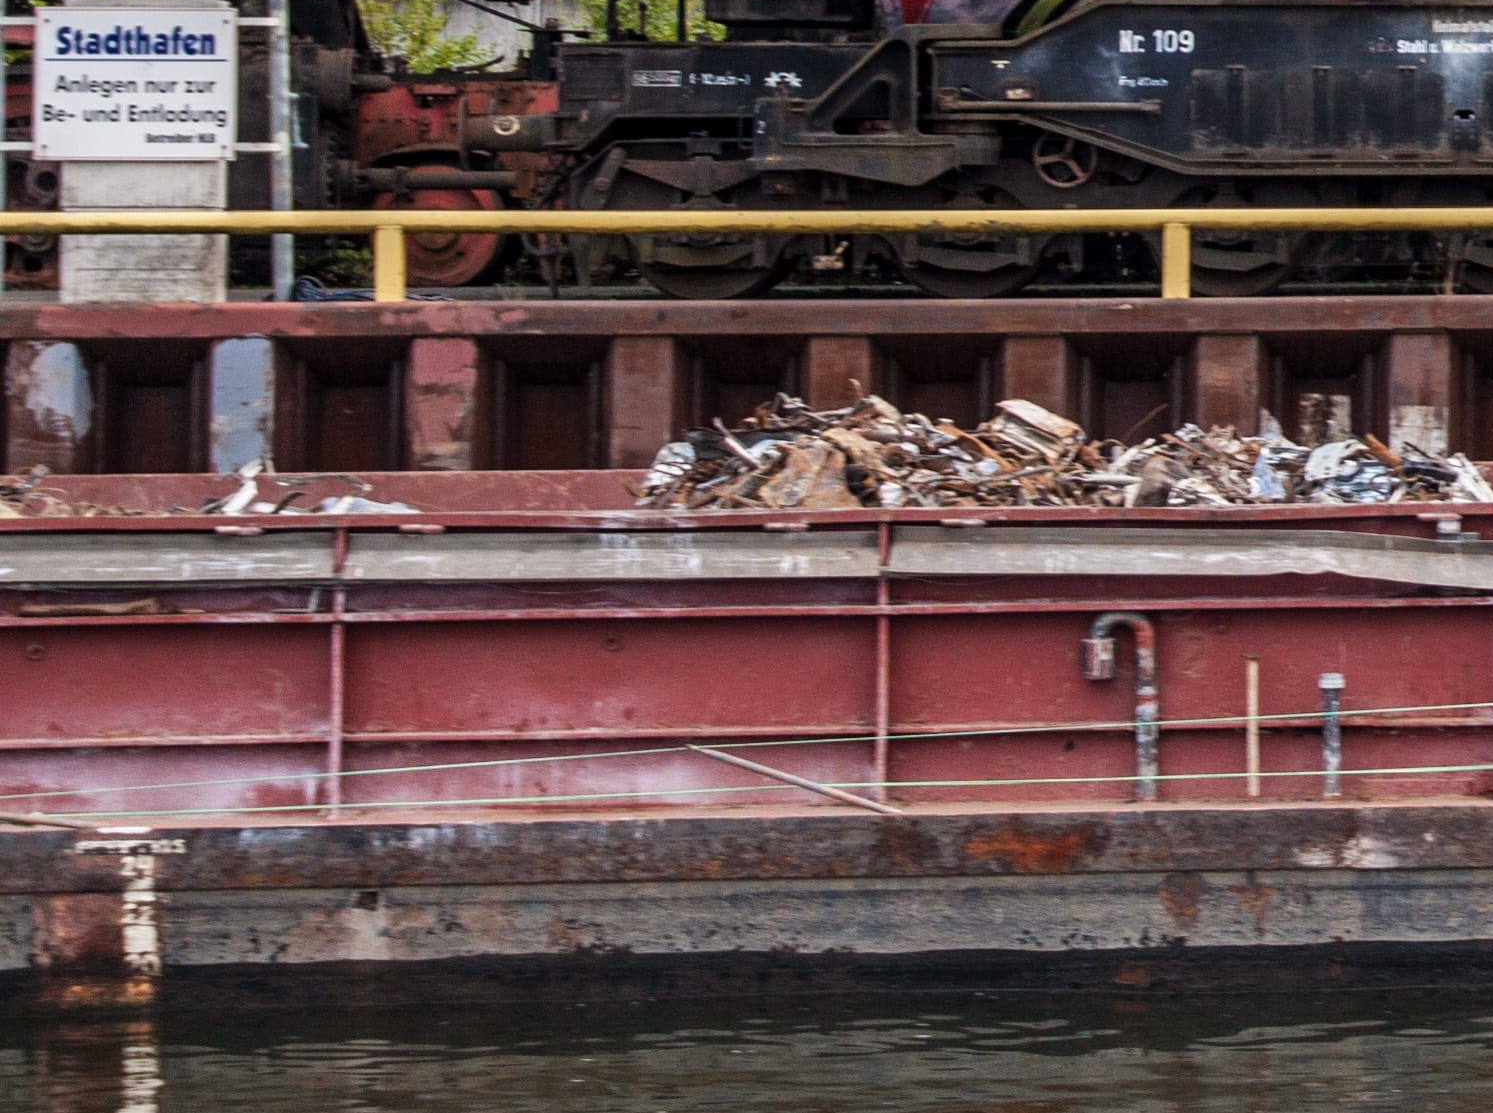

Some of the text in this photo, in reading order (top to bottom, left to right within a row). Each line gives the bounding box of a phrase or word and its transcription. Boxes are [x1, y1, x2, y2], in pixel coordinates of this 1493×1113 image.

[56, 25, 216, 55] Stadthafen
[1152, 29, 1195, 53] 109
[54, 74, 217, 98] Anlegen nur zur
[43, 104, 228, 127] Be- und Entladung
